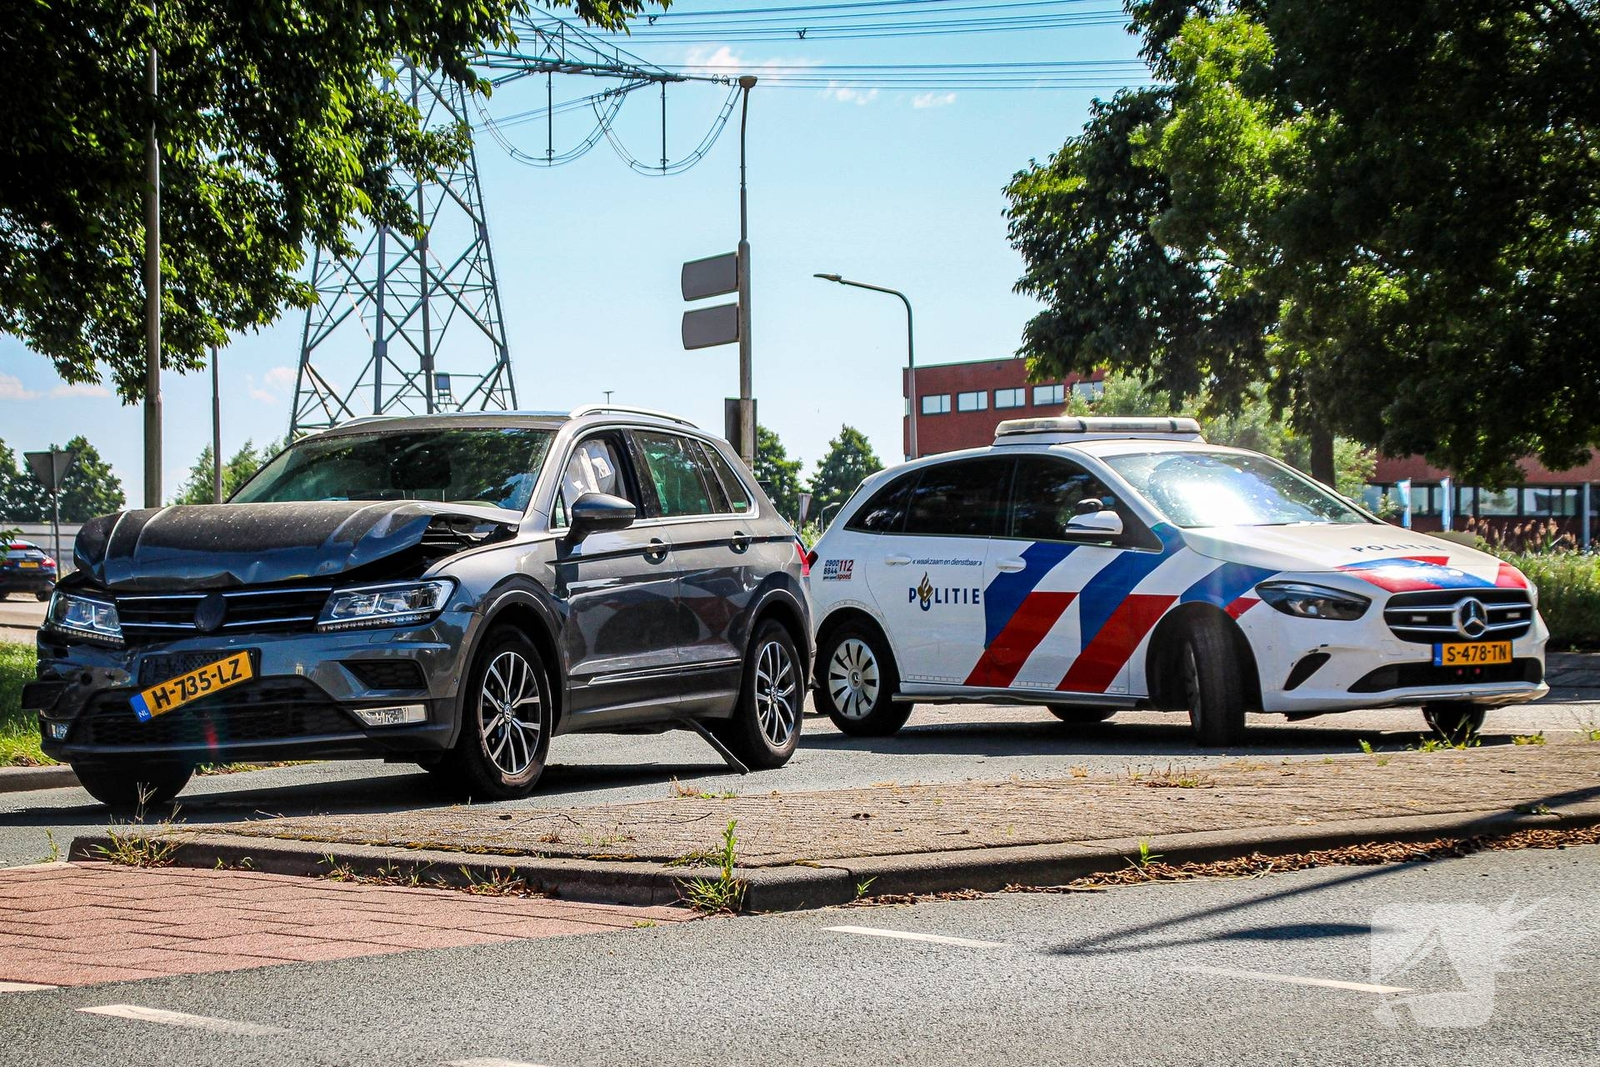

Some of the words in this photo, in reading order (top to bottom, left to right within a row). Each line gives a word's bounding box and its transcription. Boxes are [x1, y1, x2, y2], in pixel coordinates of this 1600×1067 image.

[1351, 544, 1446, 552] POLITIE
[825, 559, 839, 567] 0900
[839, 559, 854, 572] 112
[823, 567, 838, 575] 8844
[909, 588, 980, 611] POLITIE
[1447, 644, 1507, 662] S-478-TN
[151, 658, 243, 710] H-735-LZ
[138, 708, 149, 718] NL
